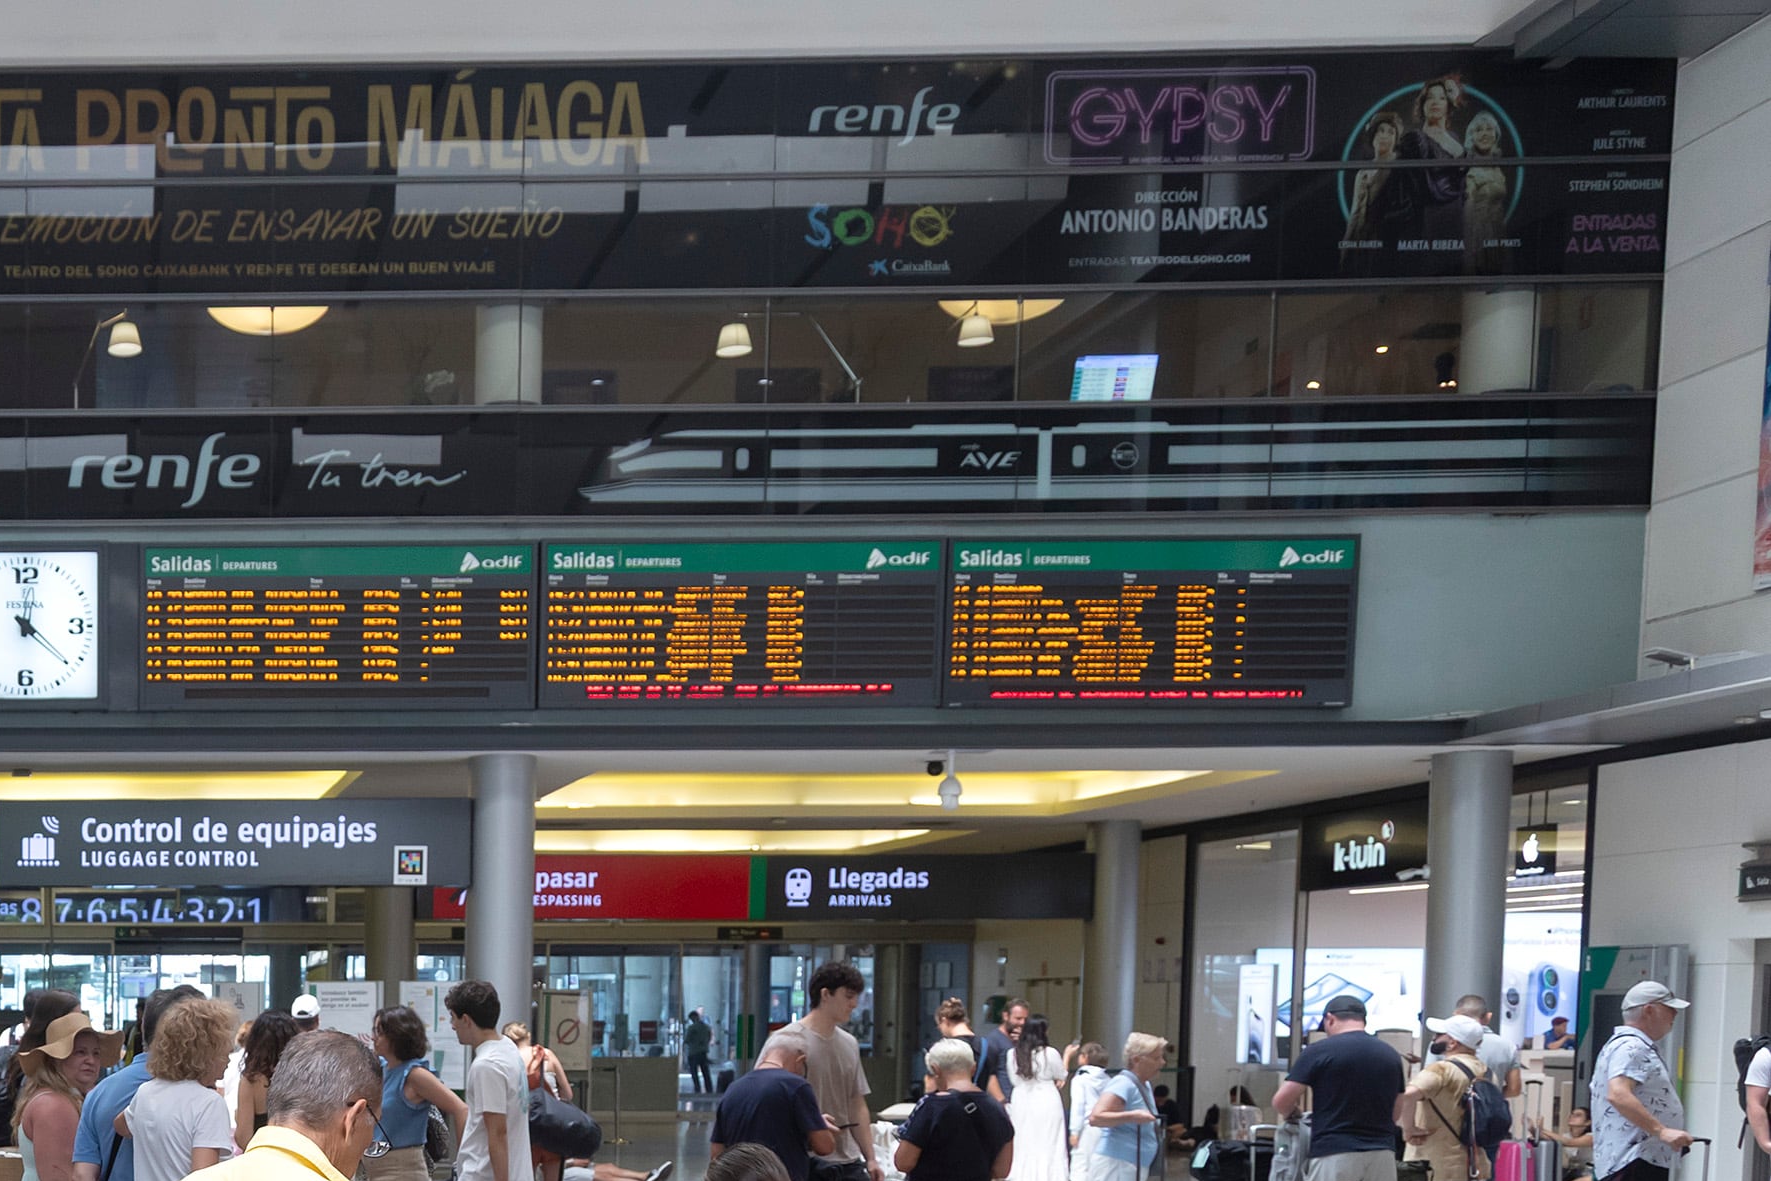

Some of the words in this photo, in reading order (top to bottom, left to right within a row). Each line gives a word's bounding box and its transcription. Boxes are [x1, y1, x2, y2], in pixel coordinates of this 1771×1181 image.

[1578, 97, 1616, 109] ARTHUR
[77, 86, 333, 173] PRONTO
[368, 68, 650, 171] MÁLAGA
[808, 86, 961, 146] renfe
[1070, 85, 1292, 145] GYPSY
[1593, 139, 1614, 151] JULE
[1569, 180, 1610, 192] STEPHEN
[1611, 178, 1664, 191] SONDHEIM
[1134, 186, 1198, 204] DIRECCIÓN
[0, 200, 162, 243] EMOCIÓN
[171, 210, 221, 242] DE
[227, 207, 382, 241] ENSAYAR
[391, 206, 439, 239] UN
[448, 199, 563, 239] SUEÑO
[804, 202, 956, 248] SOHO
[1061, 207, 1155, 234] ANTONIO
[1161, 205, 1268, 232] BANDERAS
[1572, 214, 1657, 231] ENTRADAS
[1397, 240, 1429, 250] MARTA
[1432, 240, 1465, 250] RIBERA
[1566, 237, 1578, 253] A
[1583, 237, 1604, 252] LA
[1606, 235, 1661, 251] VENTA
[891, 259, 952, 273] CaixaBank
[1069, 256, 1126, 267] ENTRADAS
[1130, 253, 1251, 266] TEATRODELSOHO.COM
[4, 265, 60, 278] TEATRO
[65, 265, 92, 278] DEL
[97, 264, 139, 277] SOHO
[143, 263, 229, 277] CAIXABANK
[247, 263, 293, 276] RENFE
[298, 263, 316, 275] TE
[320, 262, 378, 275] DESEAN
[383, 262, 404, 274] UN
[408, 261, 449, 274] BUEN
[453, 261, 496, 274] VIAJE
[960, 451, 1022, 470] AVE
[68, 431, 260, 509] renfe
[298, 448, 344, 492] Tu
[360, 464, 466, 492] tren
[152, 555, 211, 572] Salidas
[223, 560, 277, 570] DEPARTURES
[481, 554, 522, 569] adif
[553, 551, 614, 569] Salidas
[625, 556, 681, 567] DEPARTURES
[888, 551, 929, 566] adif
[960, 549, 1022, 566] Salidas
[1034, 555, 1090, 565] DEPARTURES
[1302, 549, 1344, 564] adif
[12, 567, 38, 584] 12
[69, 618, 84, 634] 3
[18, 670, 34, 686] 6
[81, 817, 181, 843] Control
[193, 817, 227, 843] de
[238, 817, 377, 848] equipajes
[81, 851, 169, 867] LUGGAGE
[174, 851, 259, 867] CONTROL
[1333, 836, 1386, 872] k-tuin
[535, 871, 598, 893] pasar
[829, 867, 929, 890] Llegadas
[533, 894, 601, 906] ESPASSING
[829, 895, 891, 907] ARRIVALS
[21, 898, 41, 923] 8
